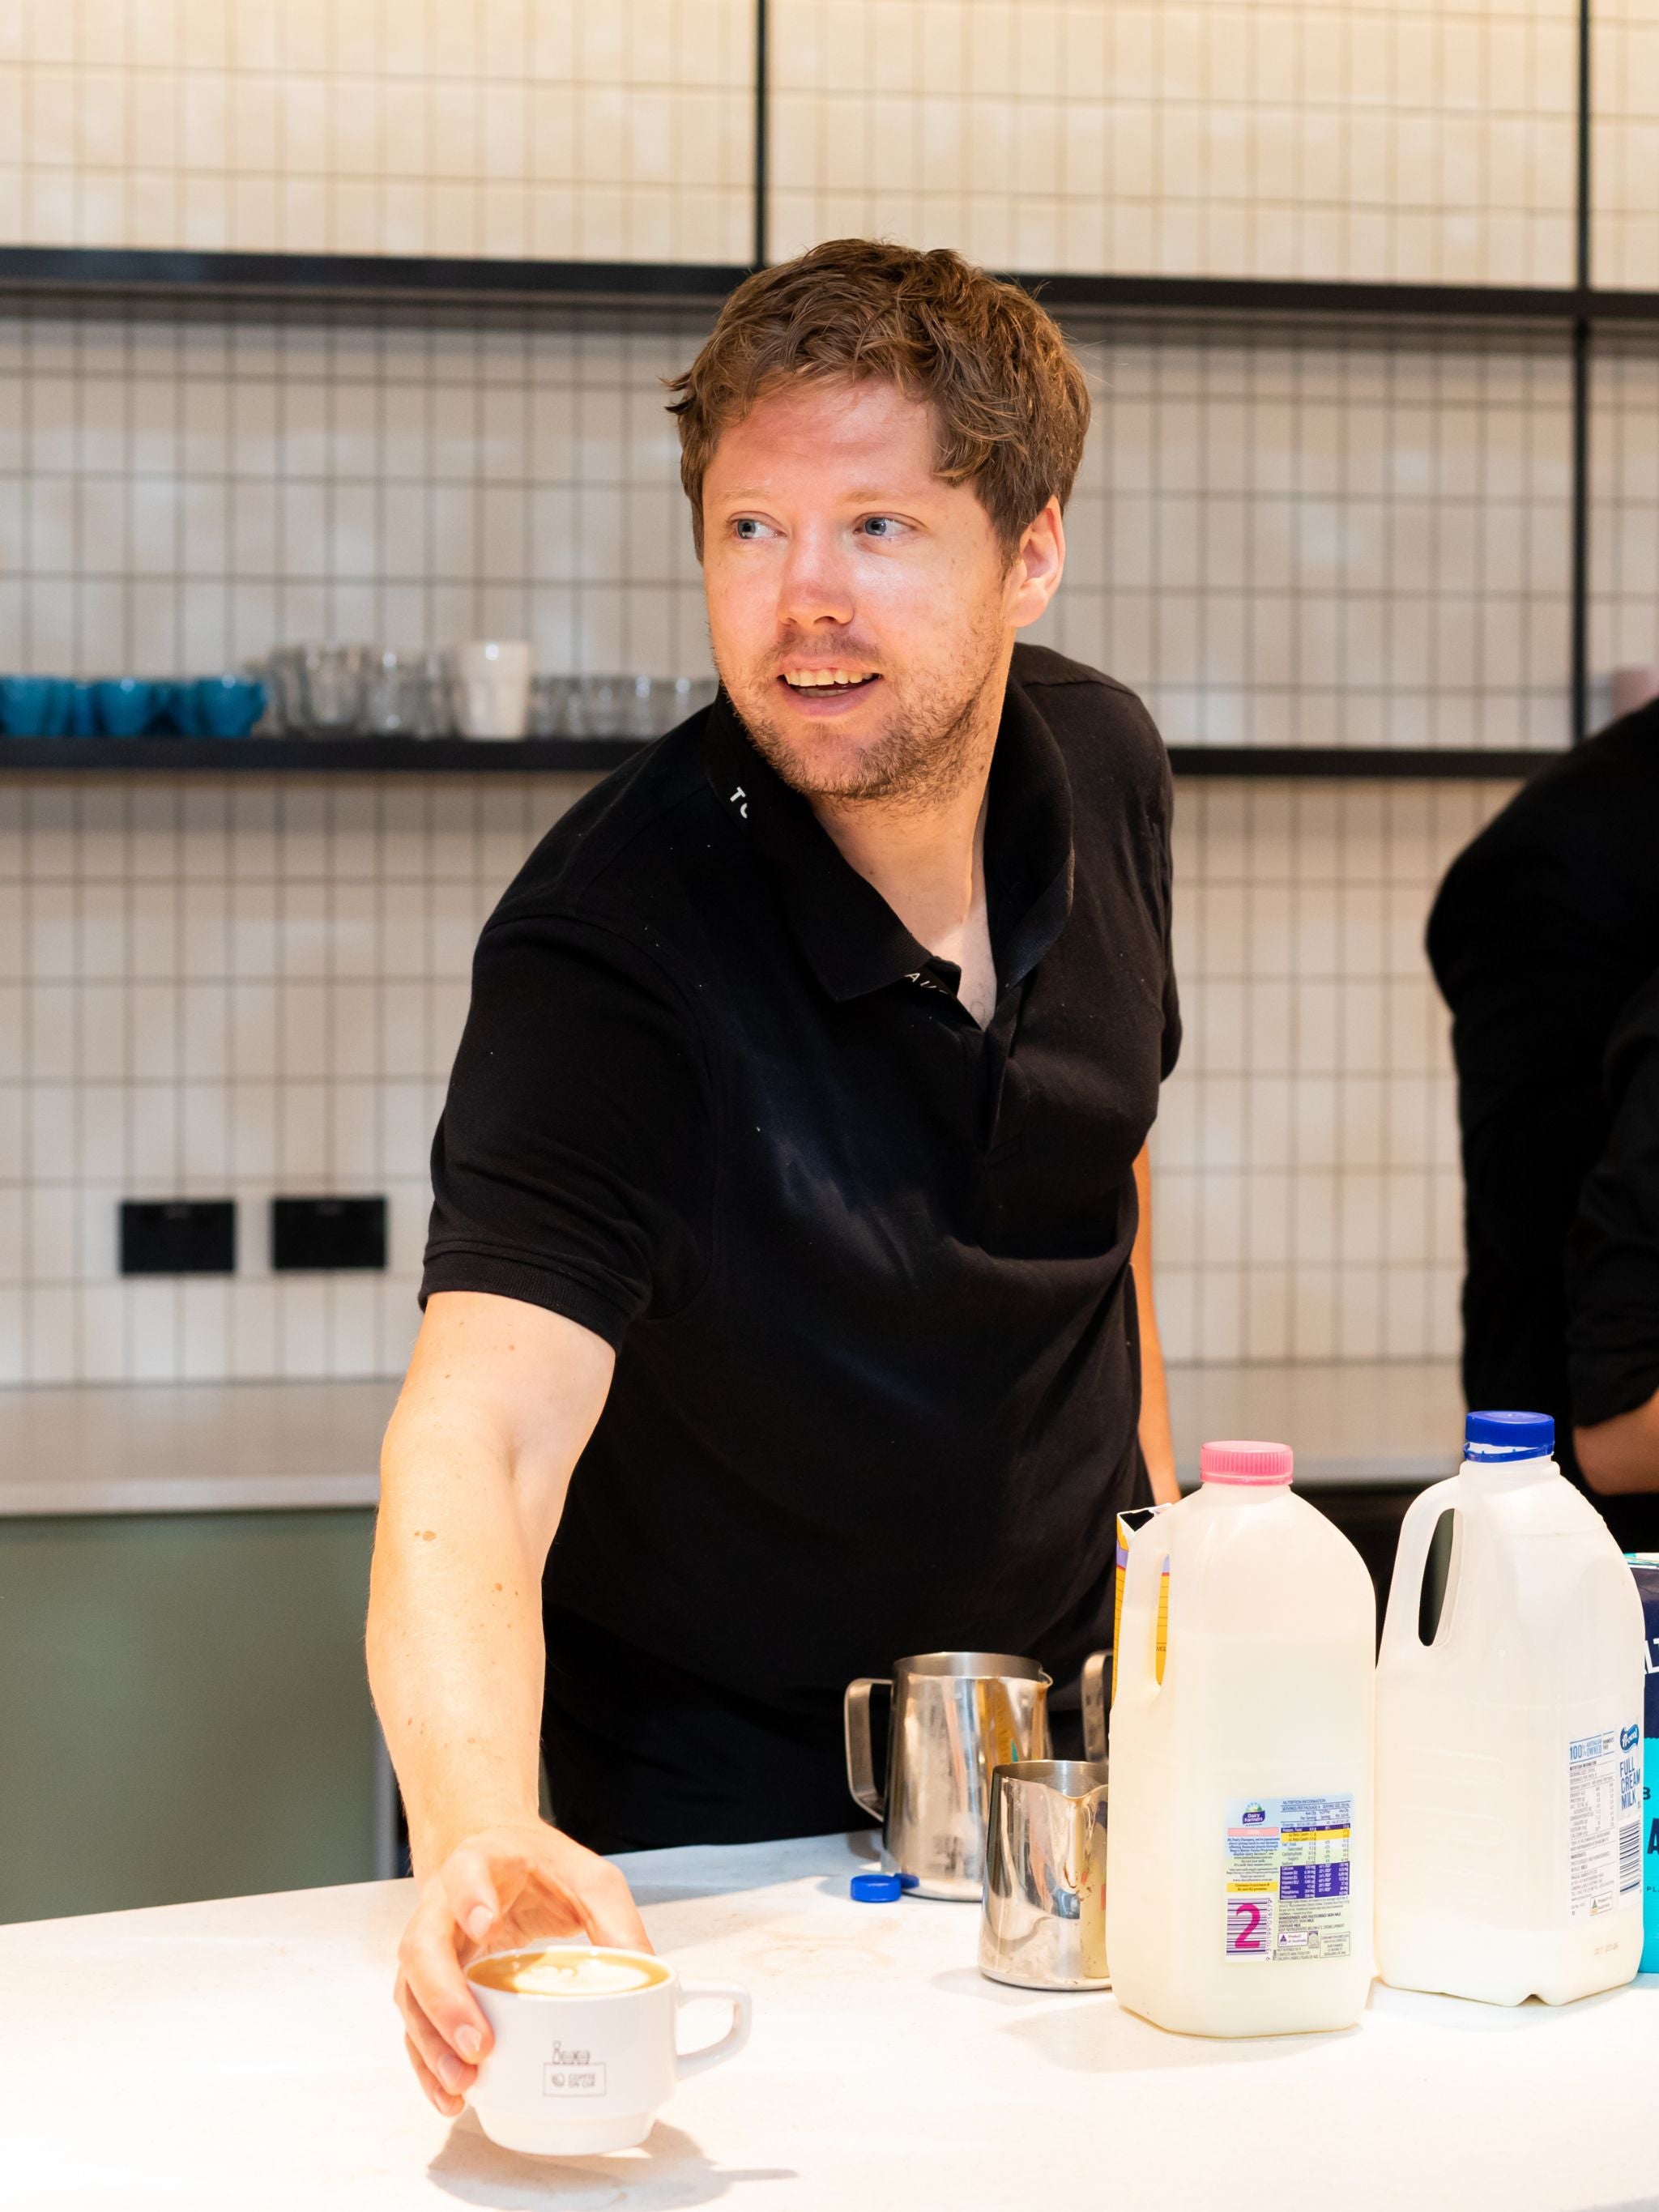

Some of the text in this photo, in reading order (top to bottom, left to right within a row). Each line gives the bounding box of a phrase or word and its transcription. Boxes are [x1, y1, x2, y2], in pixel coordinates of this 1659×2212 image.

[1620, 1756, 1635, 1778] FULL
[1621, 1788, 1636, 1811] MILK
[1235, 1903, 1260, 1949] 2
